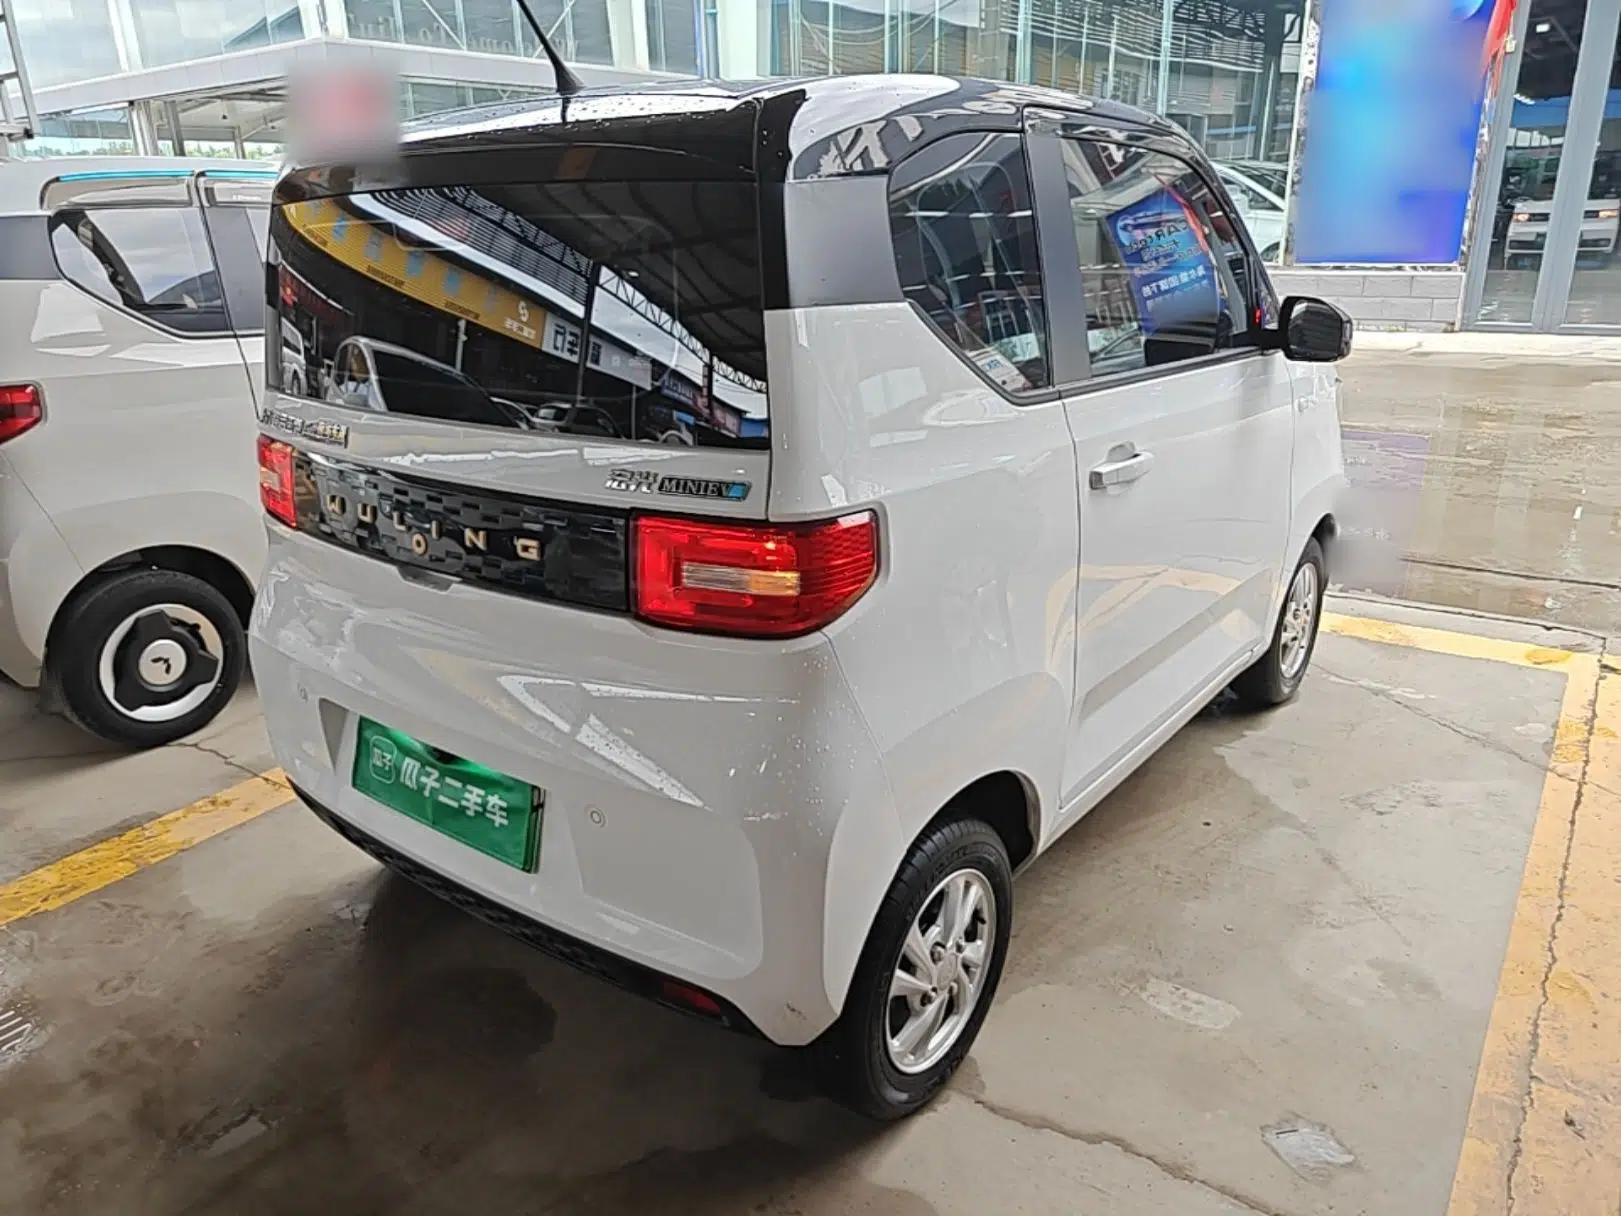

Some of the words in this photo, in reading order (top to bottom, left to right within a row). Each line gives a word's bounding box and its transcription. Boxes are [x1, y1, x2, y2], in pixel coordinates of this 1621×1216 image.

[326, 494, 543, 562] WULING
[400, 756, 509, 828] 瓜子二手车
